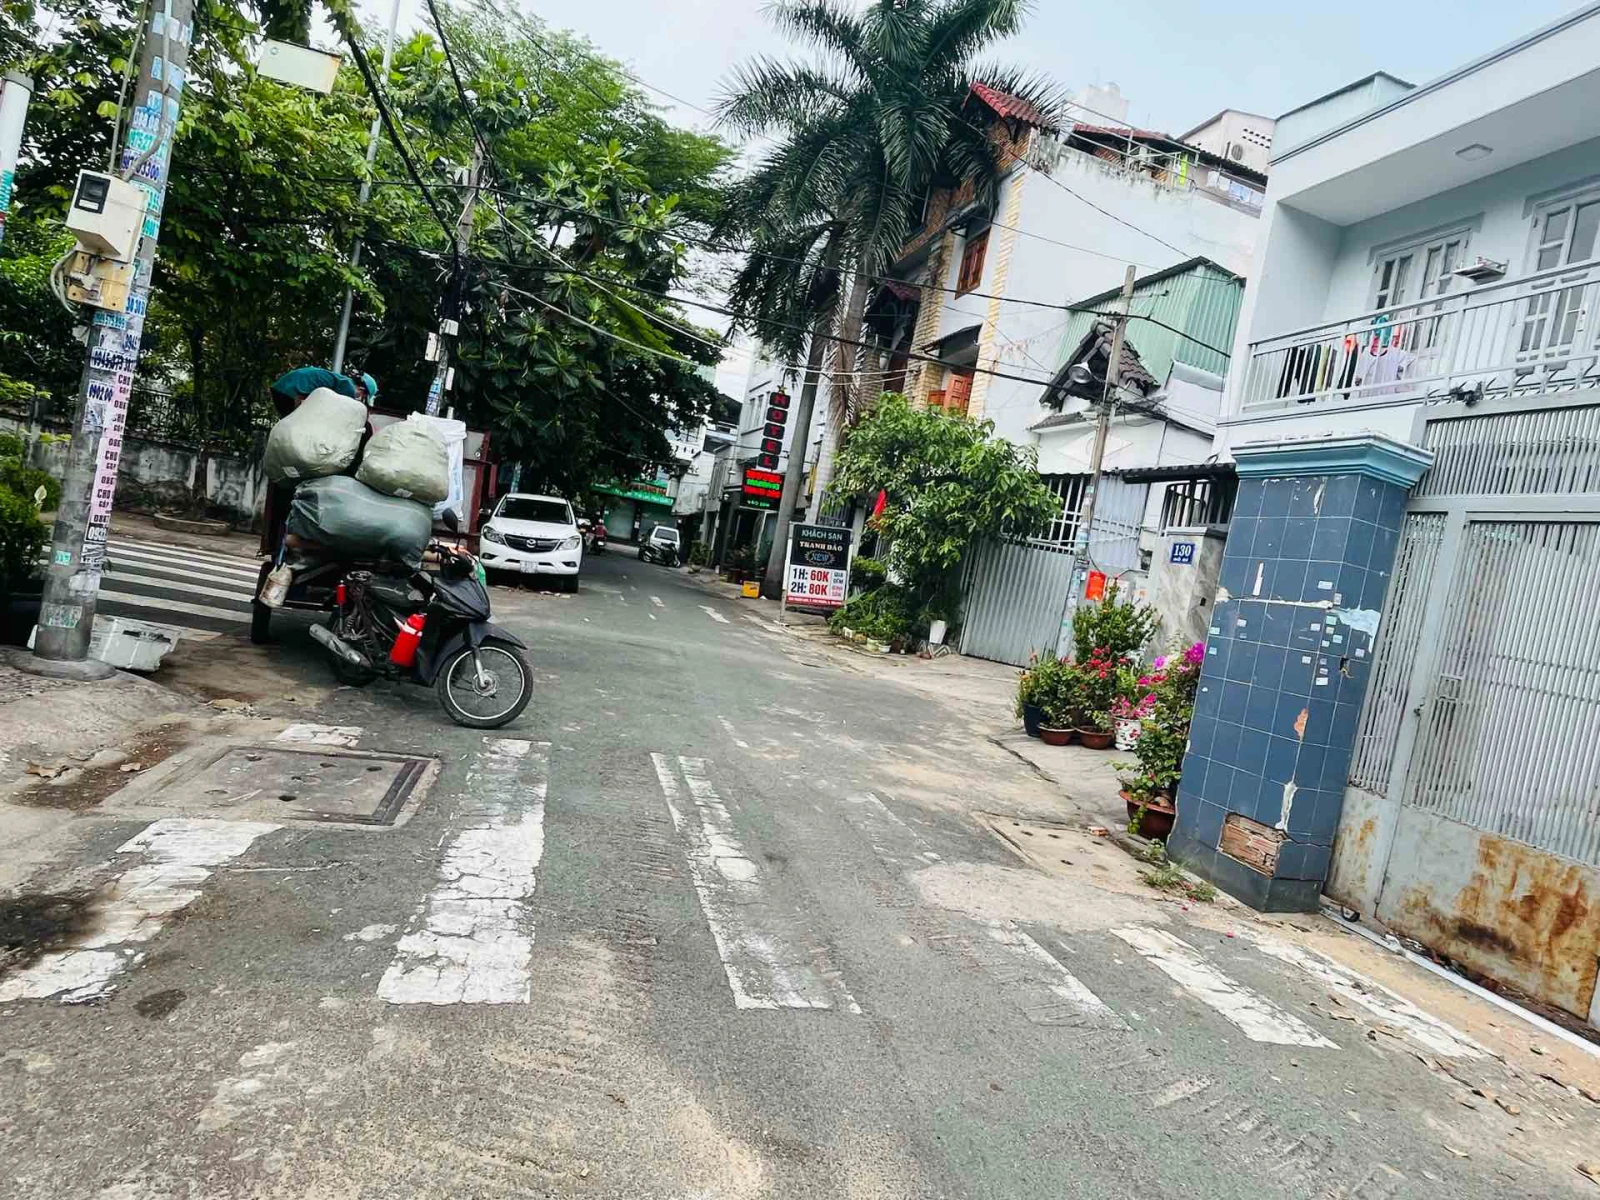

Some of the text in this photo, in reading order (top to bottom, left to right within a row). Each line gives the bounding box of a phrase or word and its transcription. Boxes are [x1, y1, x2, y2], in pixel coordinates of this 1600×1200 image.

[761, 393, 789, 467] HOTEL
[802, 528, 827, 538] KHÁCH
[800, 541, 826, 550] THANH
[1173, 544, 1192, 557] 130
[793, 567, 830, 582] 1H: 60K
[791, 582, 807, 594] 2H:
[808, 583, 828, 595] 80K
